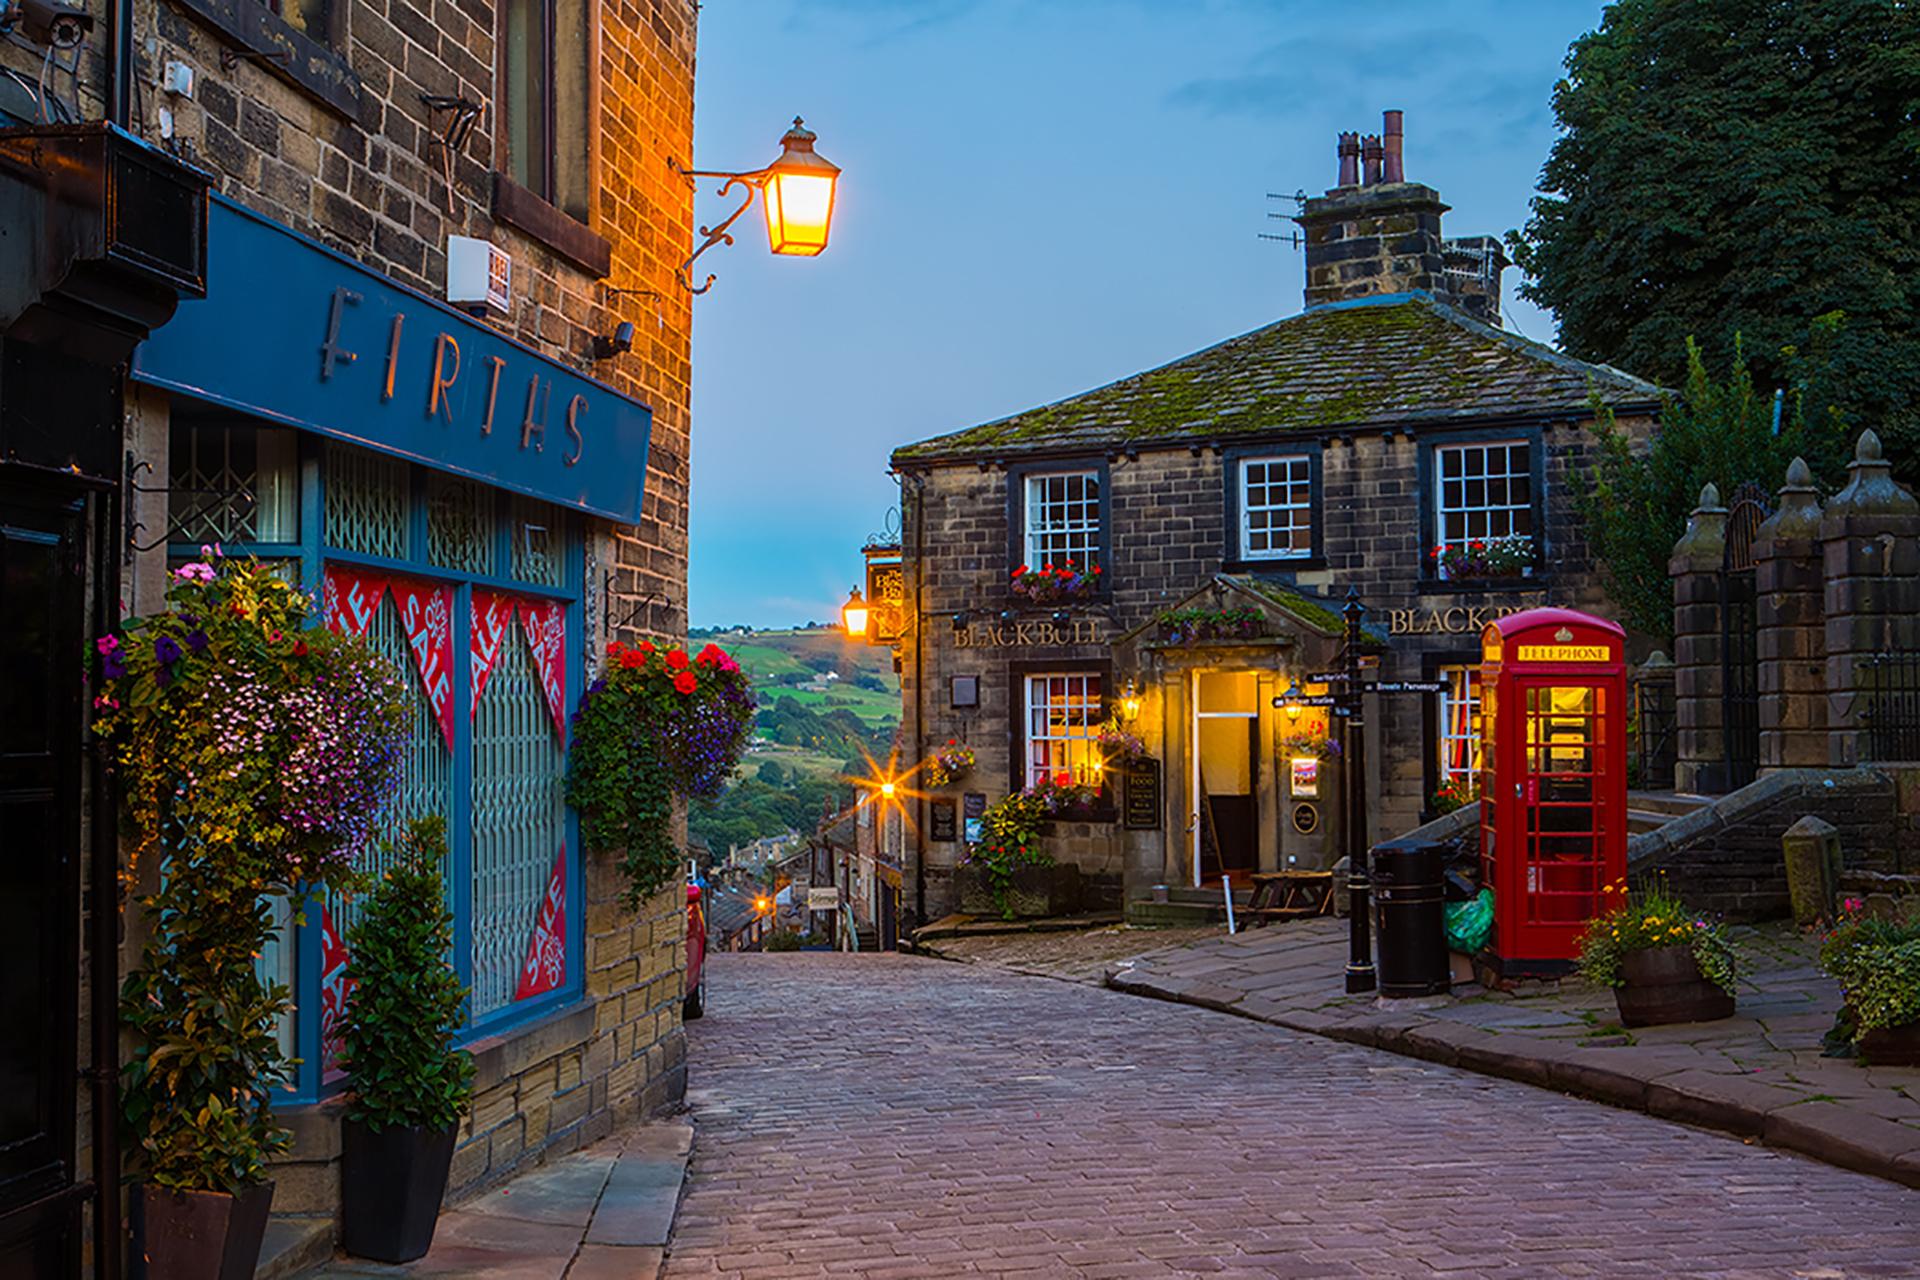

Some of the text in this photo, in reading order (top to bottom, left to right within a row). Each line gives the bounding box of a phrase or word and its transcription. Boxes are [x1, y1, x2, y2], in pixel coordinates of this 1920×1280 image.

[321, 285, 590, 467] FIRTHS
[402, 593, 450, 717] SALE
[526, 610, 561, 717] SALE
[950, 620, 1105, 649] BLACK BULL
[1389, 606, 1485, 634] BLACK
[1521, 646, 1605, 660] TELEPHONE
[527, 875, 562, 986] SALE
